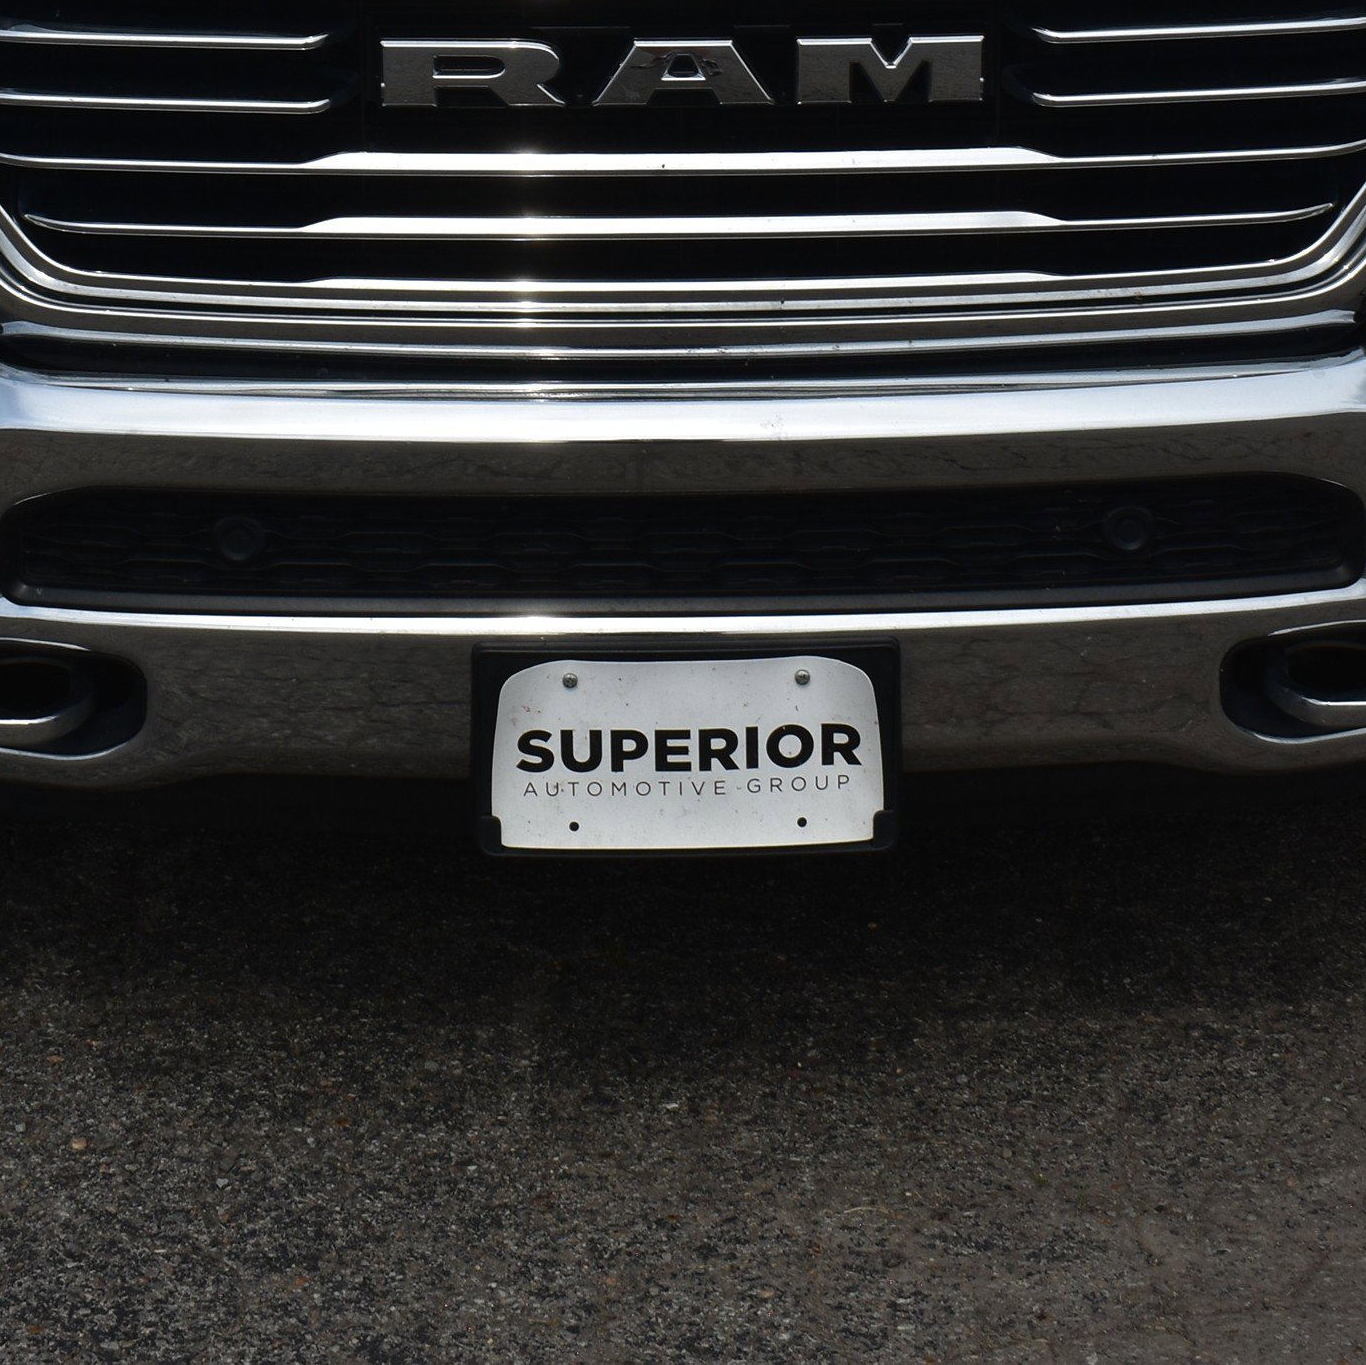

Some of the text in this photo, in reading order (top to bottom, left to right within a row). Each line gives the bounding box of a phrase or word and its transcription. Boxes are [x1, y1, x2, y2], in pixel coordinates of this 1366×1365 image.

[380, 35, 984, 108] RAM
[516, 723, 862, 773] SUPERIOR
[523, 774, 851, 798] AUTOMOTIVE GROUP
